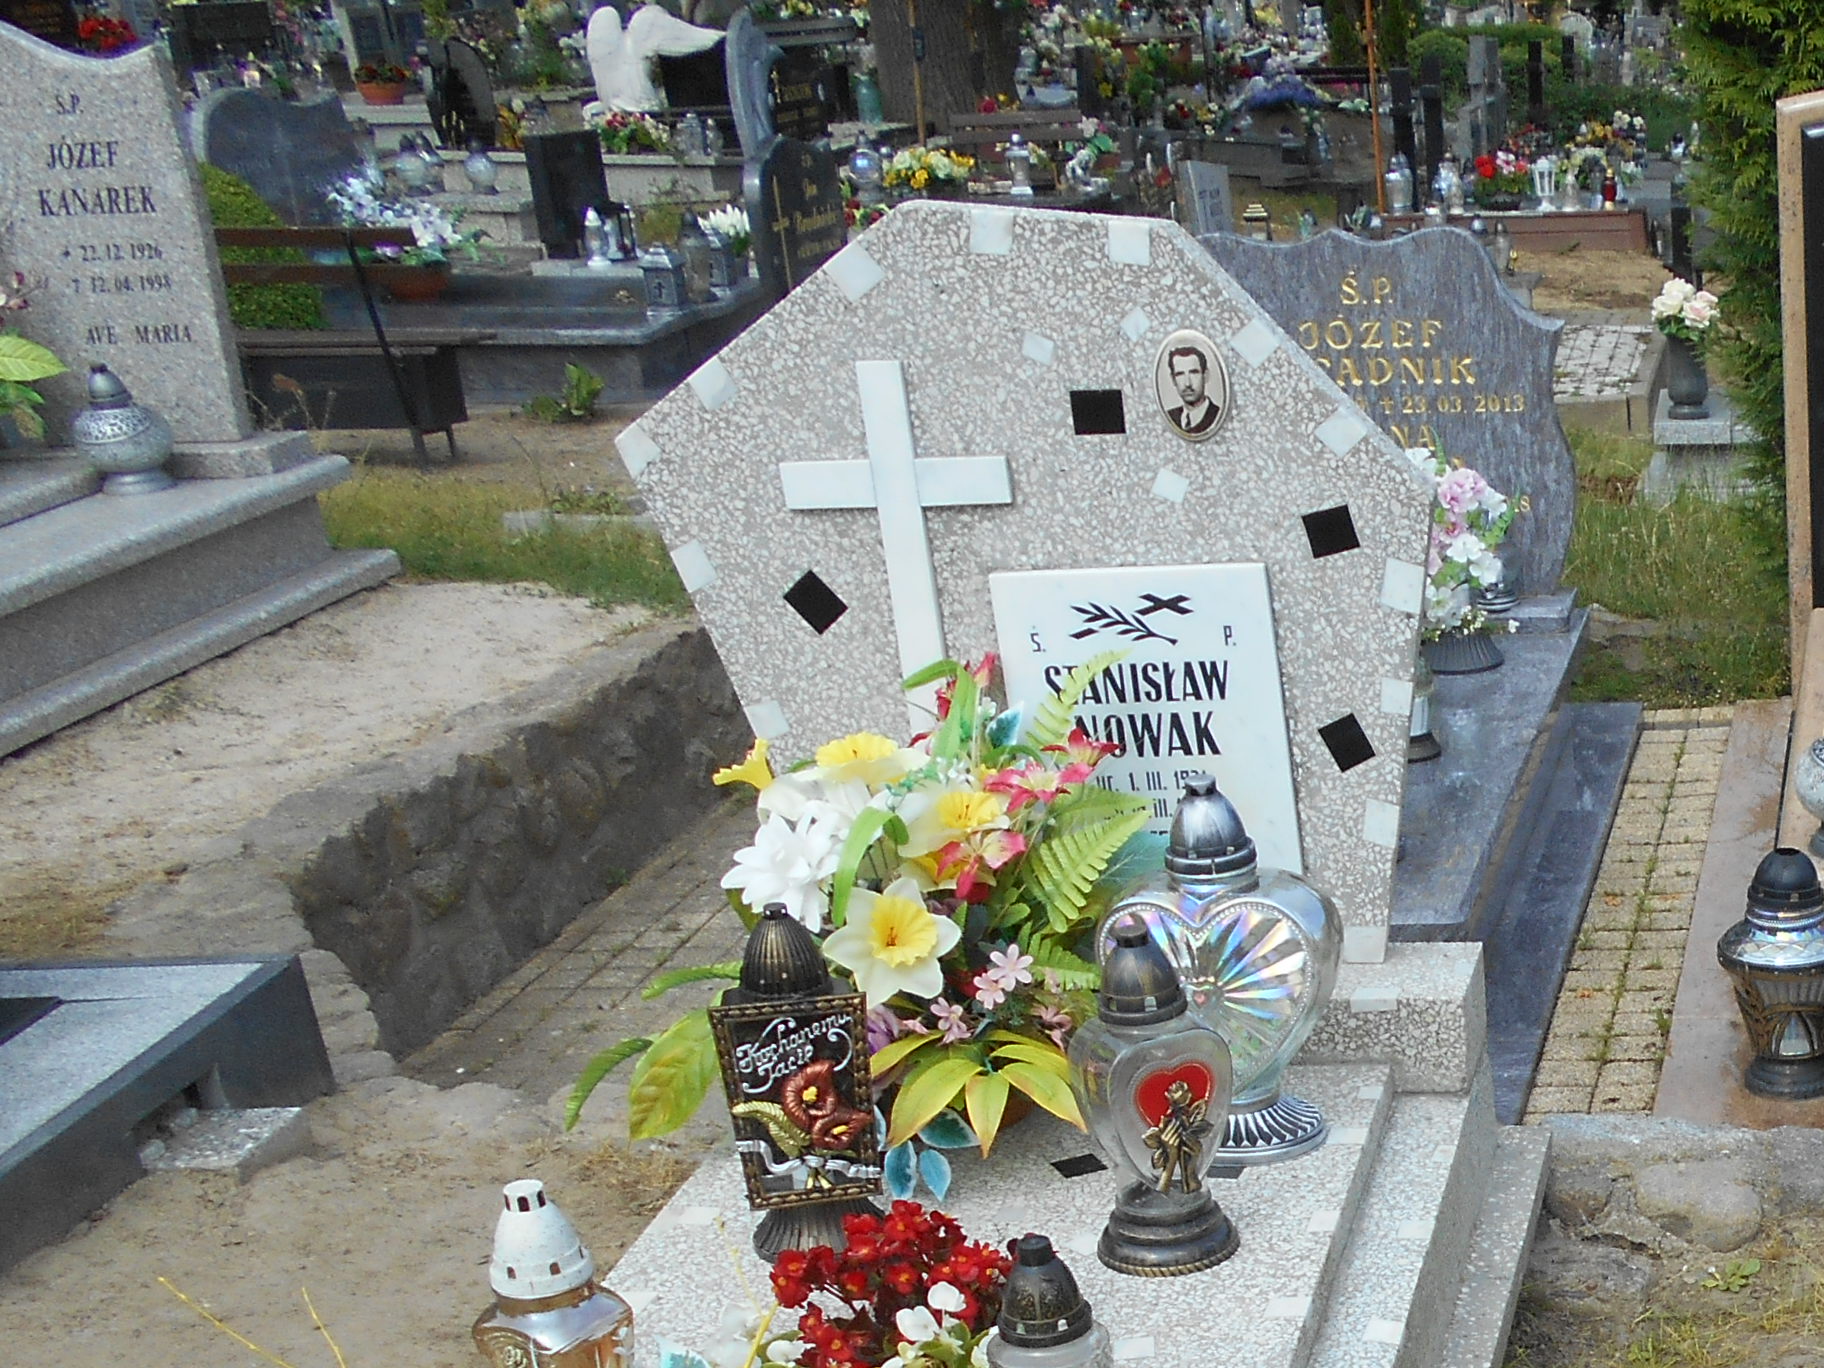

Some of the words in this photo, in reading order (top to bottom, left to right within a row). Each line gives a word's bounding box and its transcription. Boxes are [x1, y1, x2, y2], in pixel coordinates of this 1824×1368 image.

[47, 135, 120, 170] JÓZEF
[37, 186, 158, 217] KANAREK
[86, 325, 118, 346] AVE
[134, 323, 193, 344] MARIA
[1298, 313, 1443, 351] JÓZEF
[1072, 711, 1223, 760] NOWAK
[736, 1014, 854, 1073] Kochanemu
